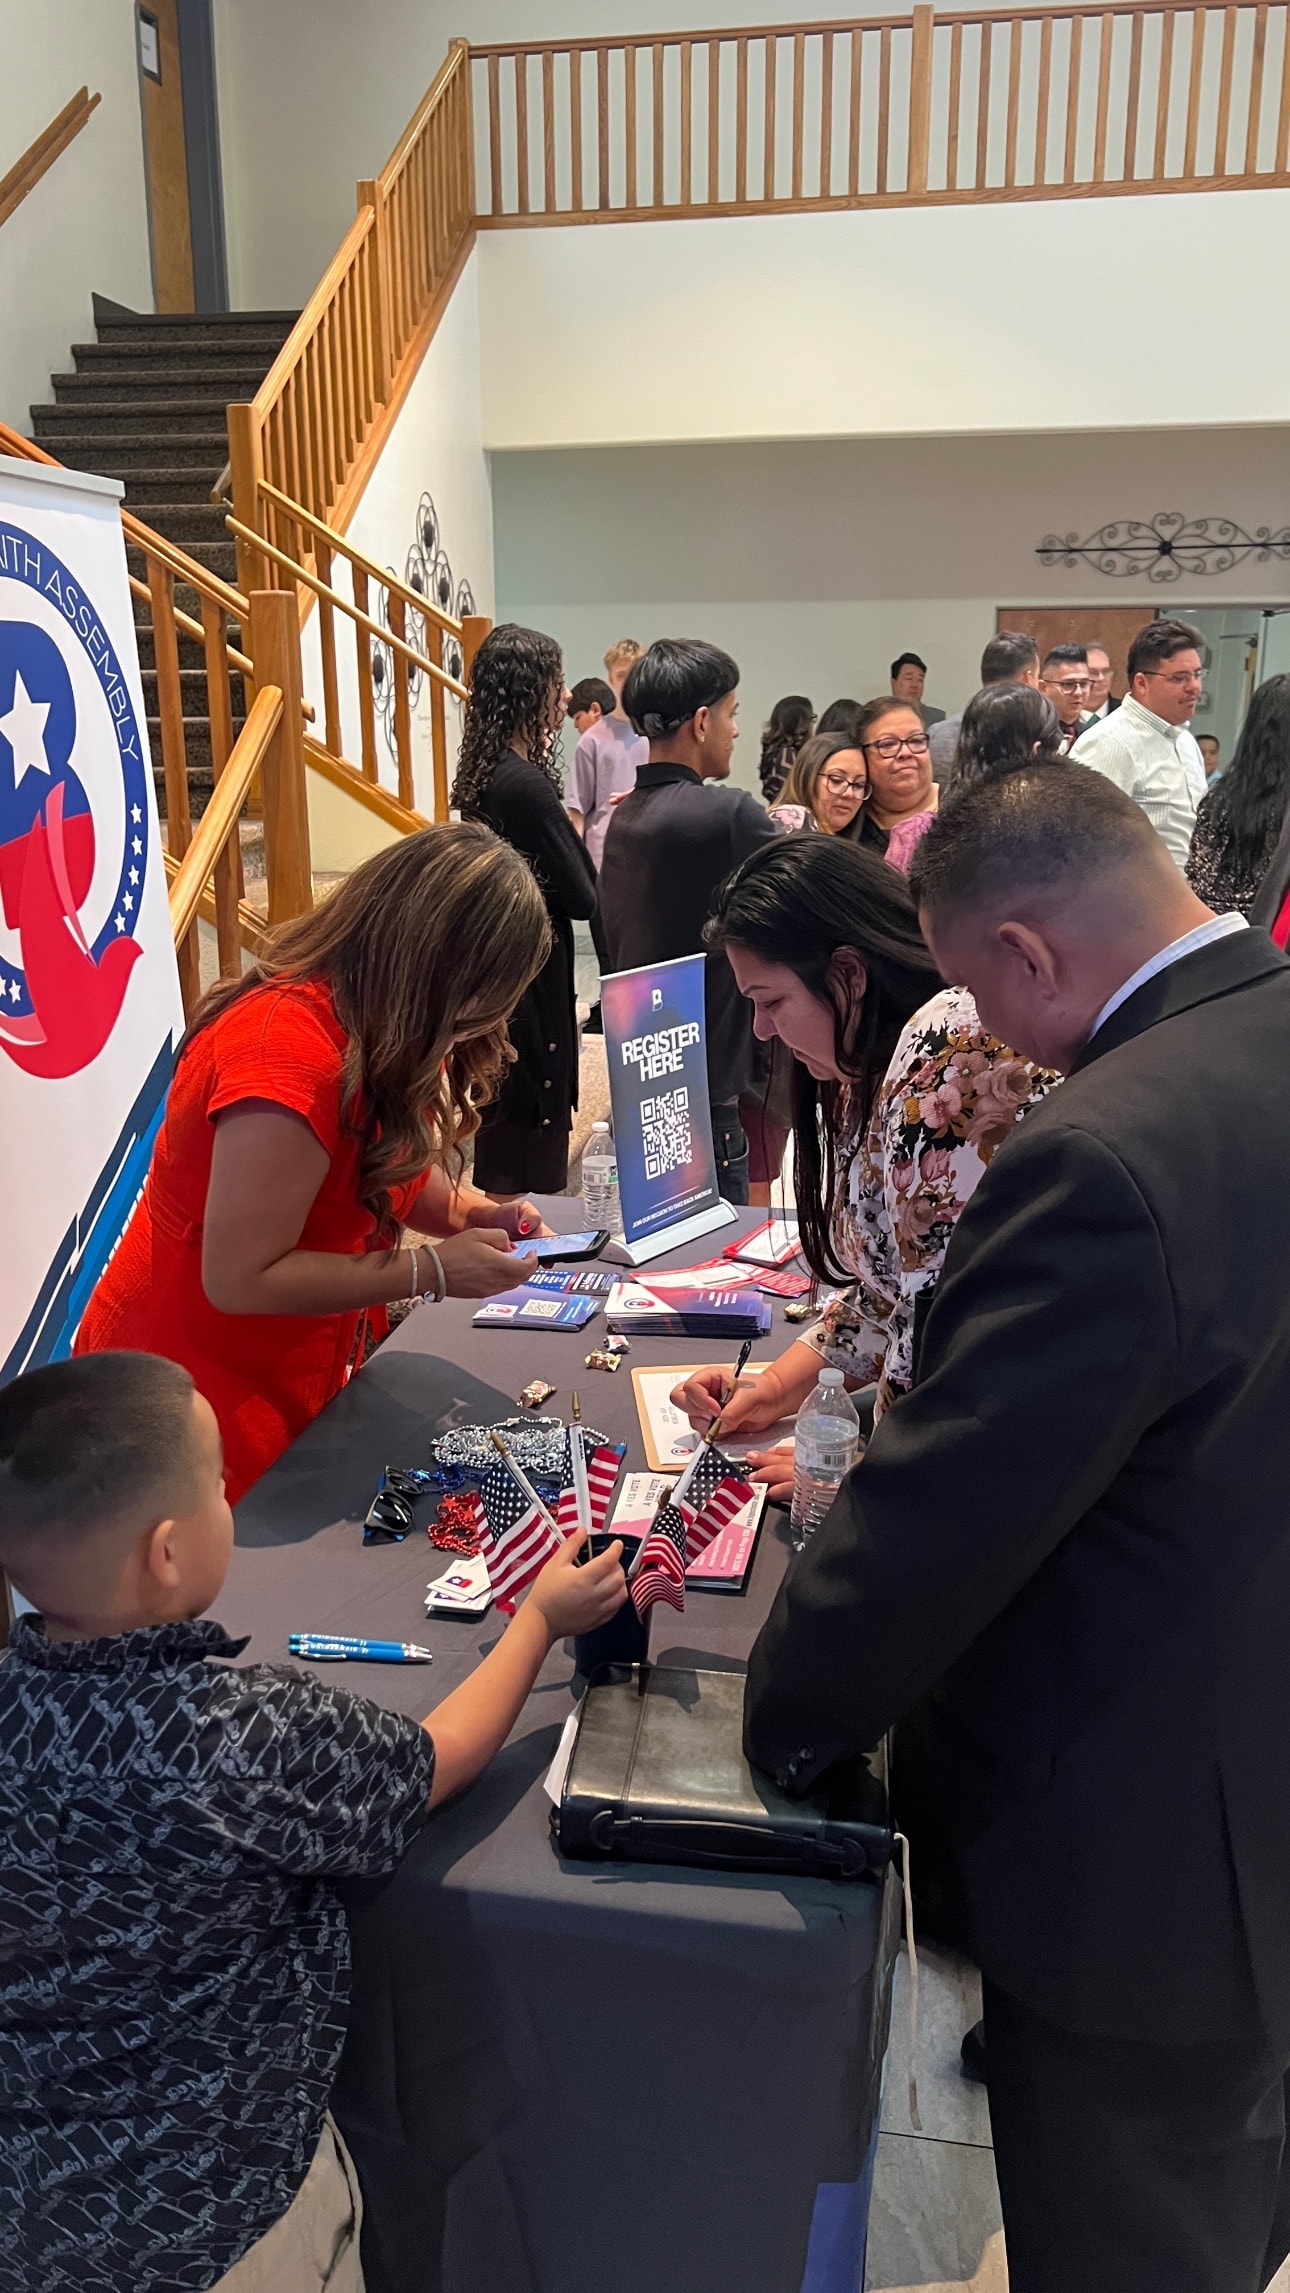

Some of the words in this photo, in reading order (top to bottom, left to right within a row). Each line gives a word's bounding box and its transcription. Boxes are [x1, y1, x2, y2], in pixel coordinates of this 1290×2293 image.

[45, 569, 139, 761] ASSEMBLY
[621, 1022, 700, 1066] REGISTER
[639, 1048, 684, 1082] HERE
[683, 1195, 694, 1205] BACK
